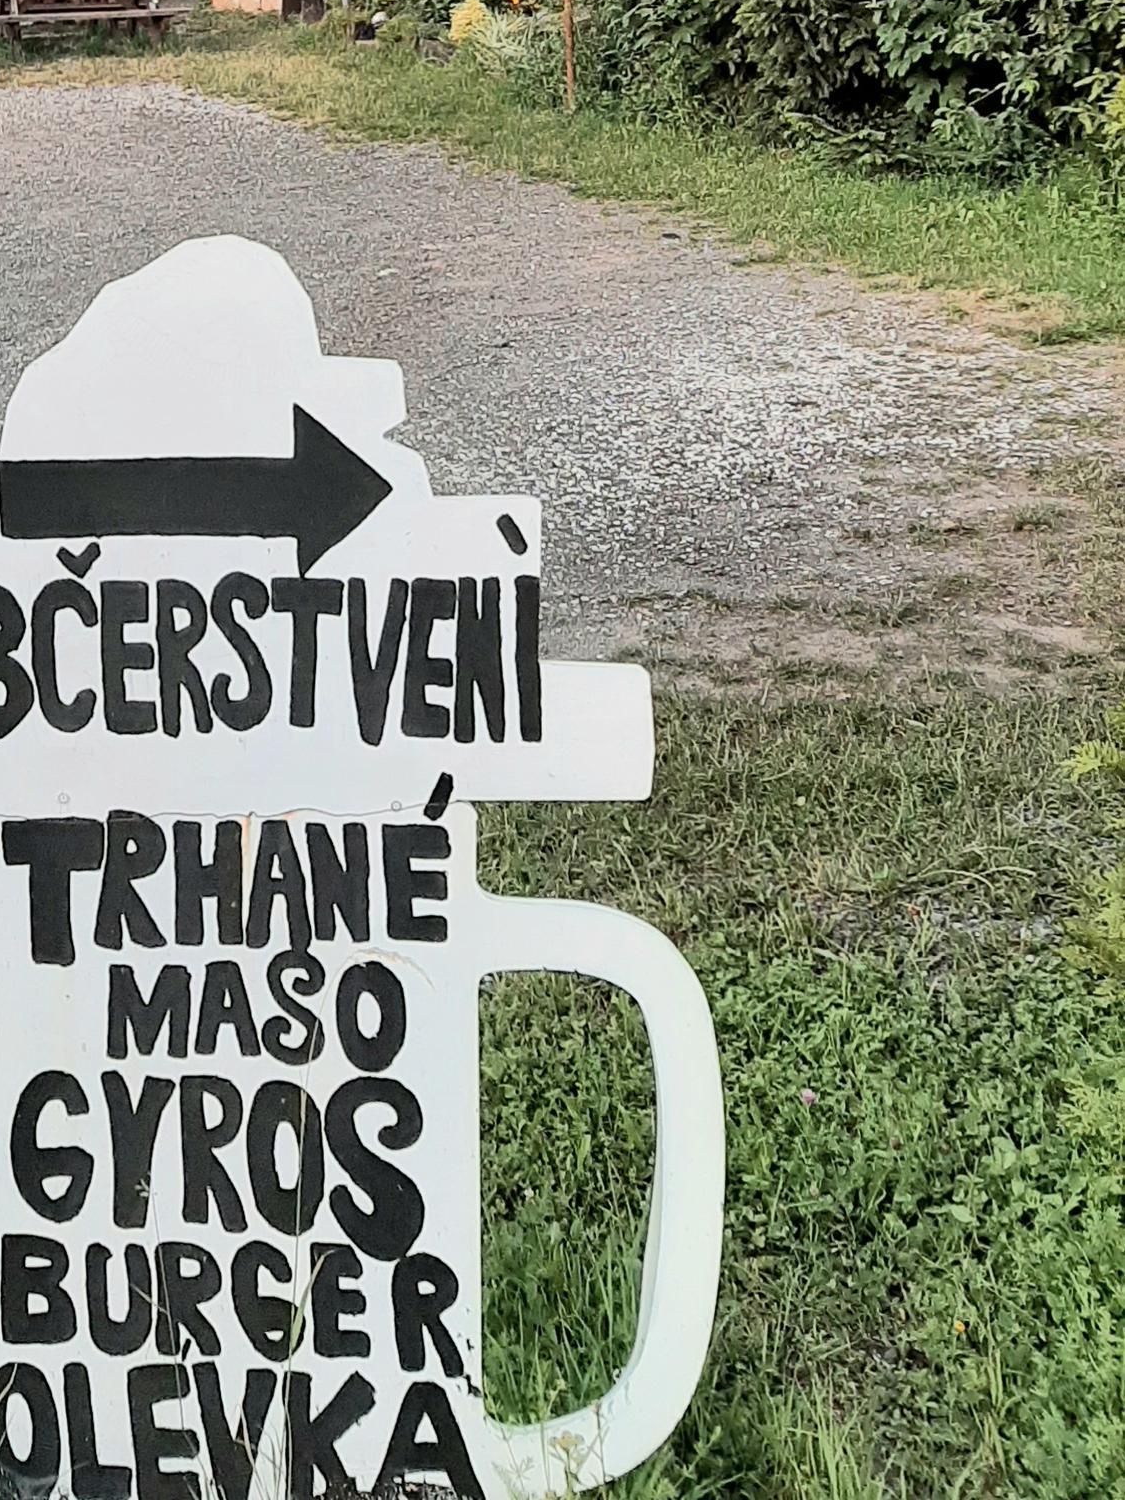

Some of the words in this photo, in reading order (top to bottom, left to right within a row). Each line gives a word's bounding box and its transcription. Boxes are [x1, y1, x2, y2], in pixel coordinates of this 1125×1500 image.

[2, 772, 453, 967] TRHANÉ
[106, 947, 407, 1073] MASO
[9, 1069, 426, 1262] GYROS
[0, 1234, 466, 1379] BURGER
